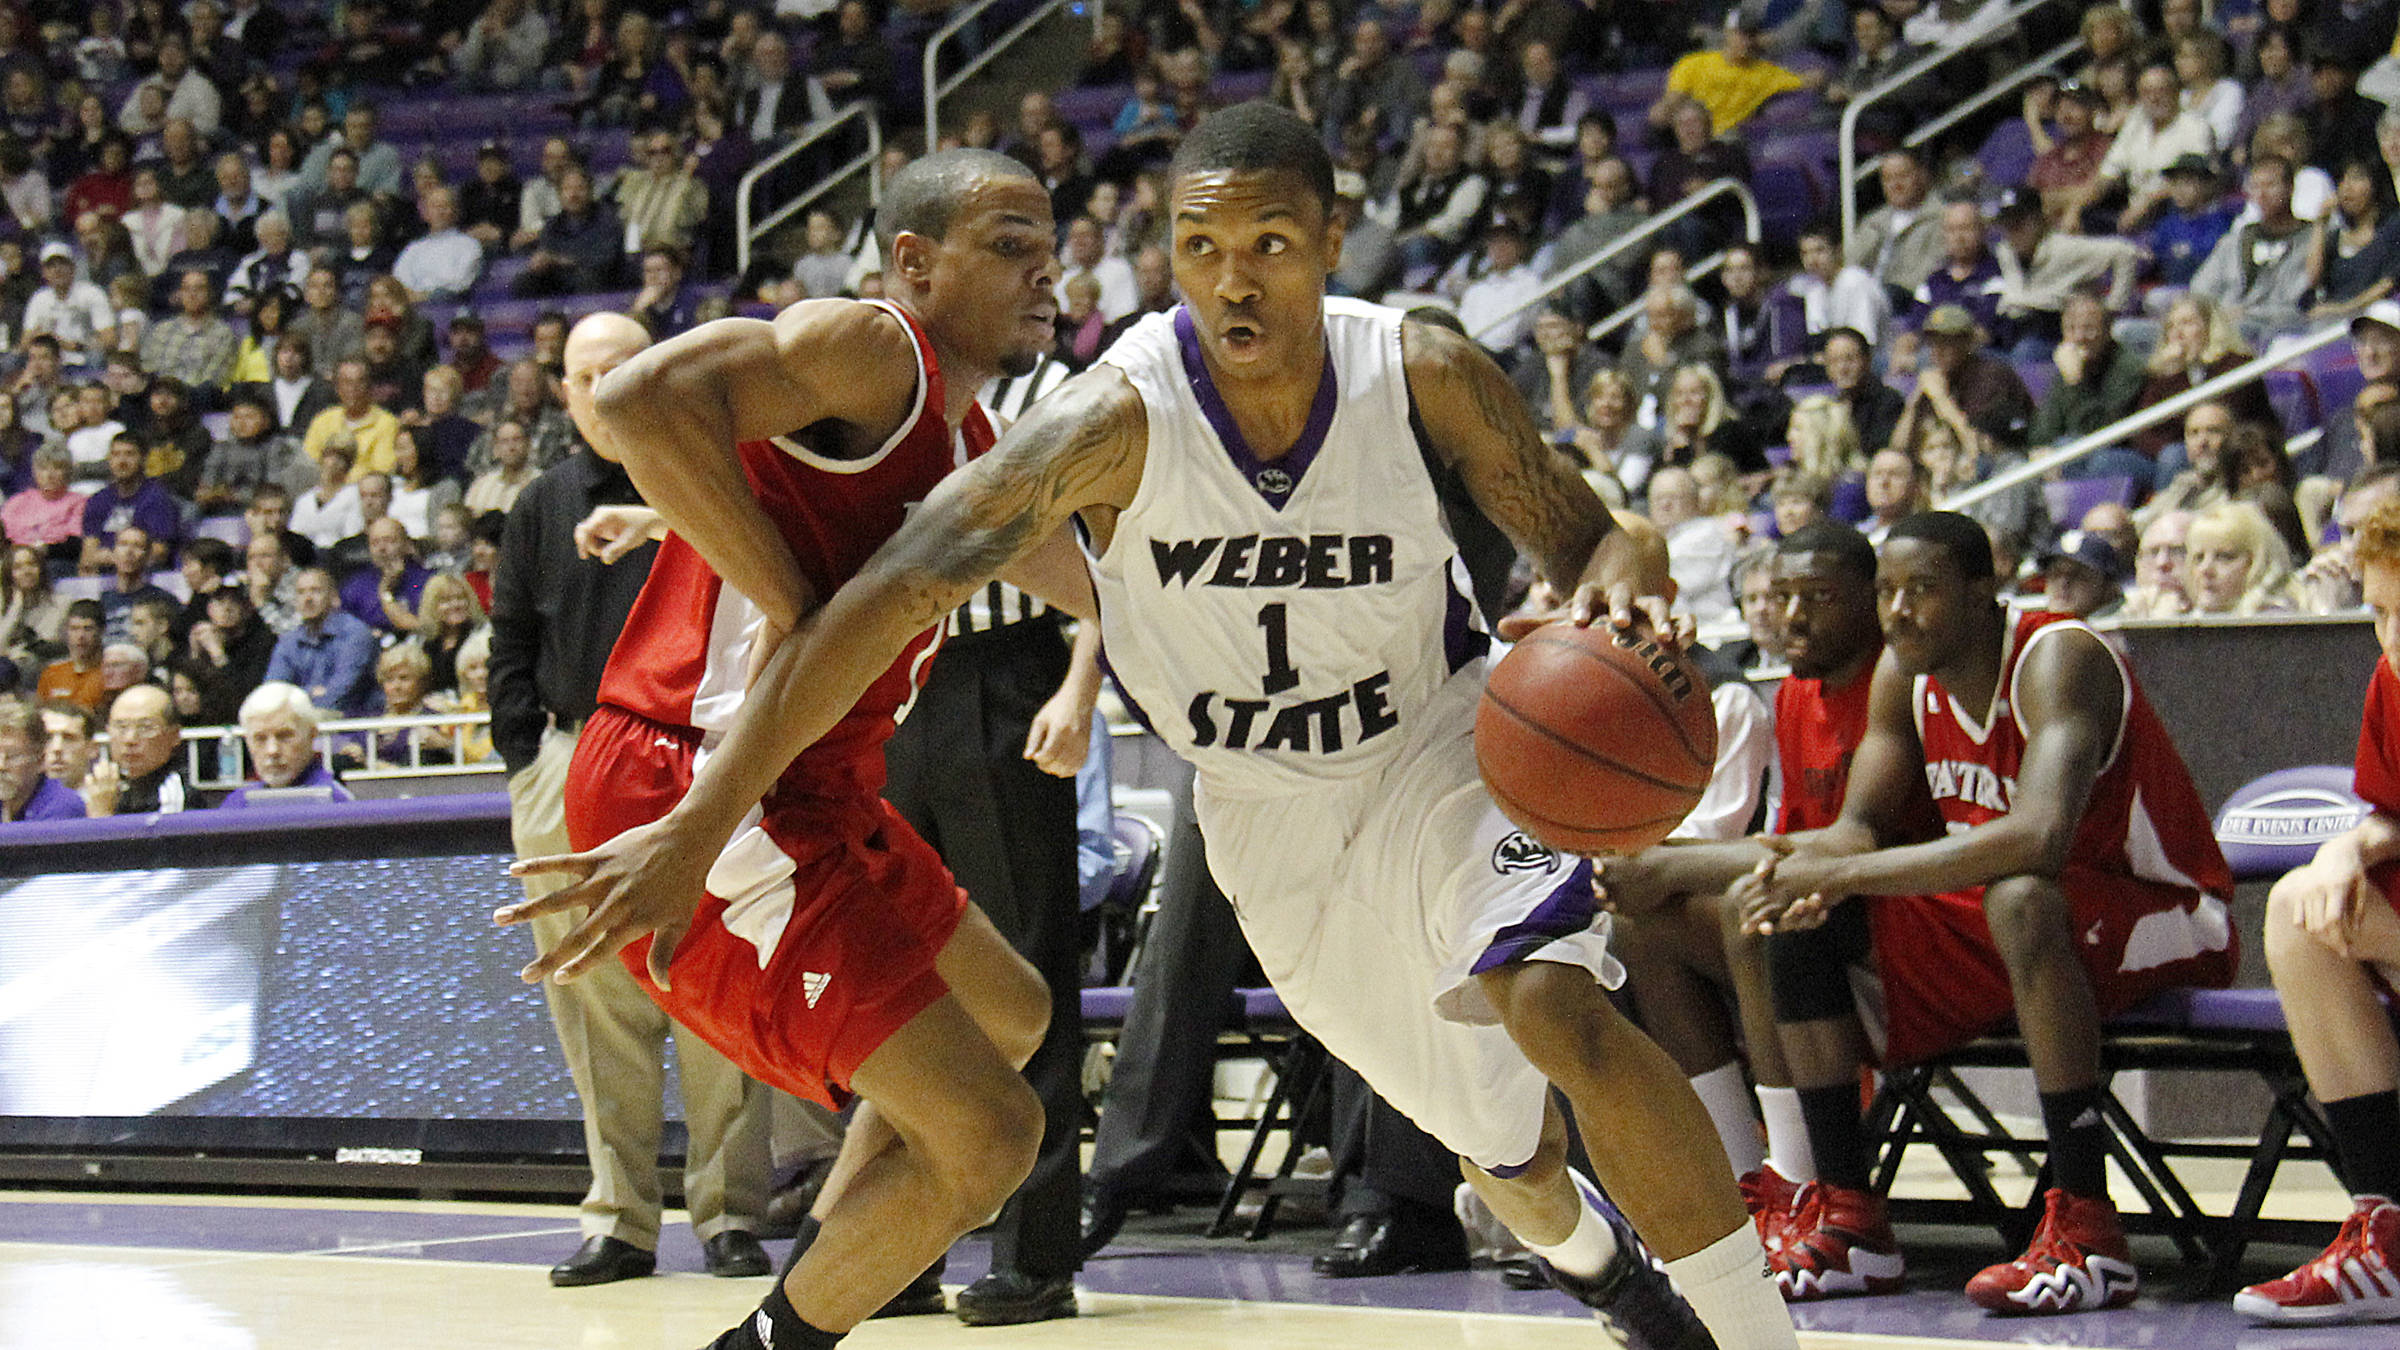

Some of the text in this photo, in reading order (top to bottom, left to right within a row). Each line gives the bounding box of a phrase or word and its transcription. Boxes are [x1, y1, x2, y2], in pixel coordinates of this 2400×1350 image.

[1149, 534, 1393, 590] WEBER
[1257, 602, 1300, 695] 1
[1188, 669, 1398, 755] STATE
